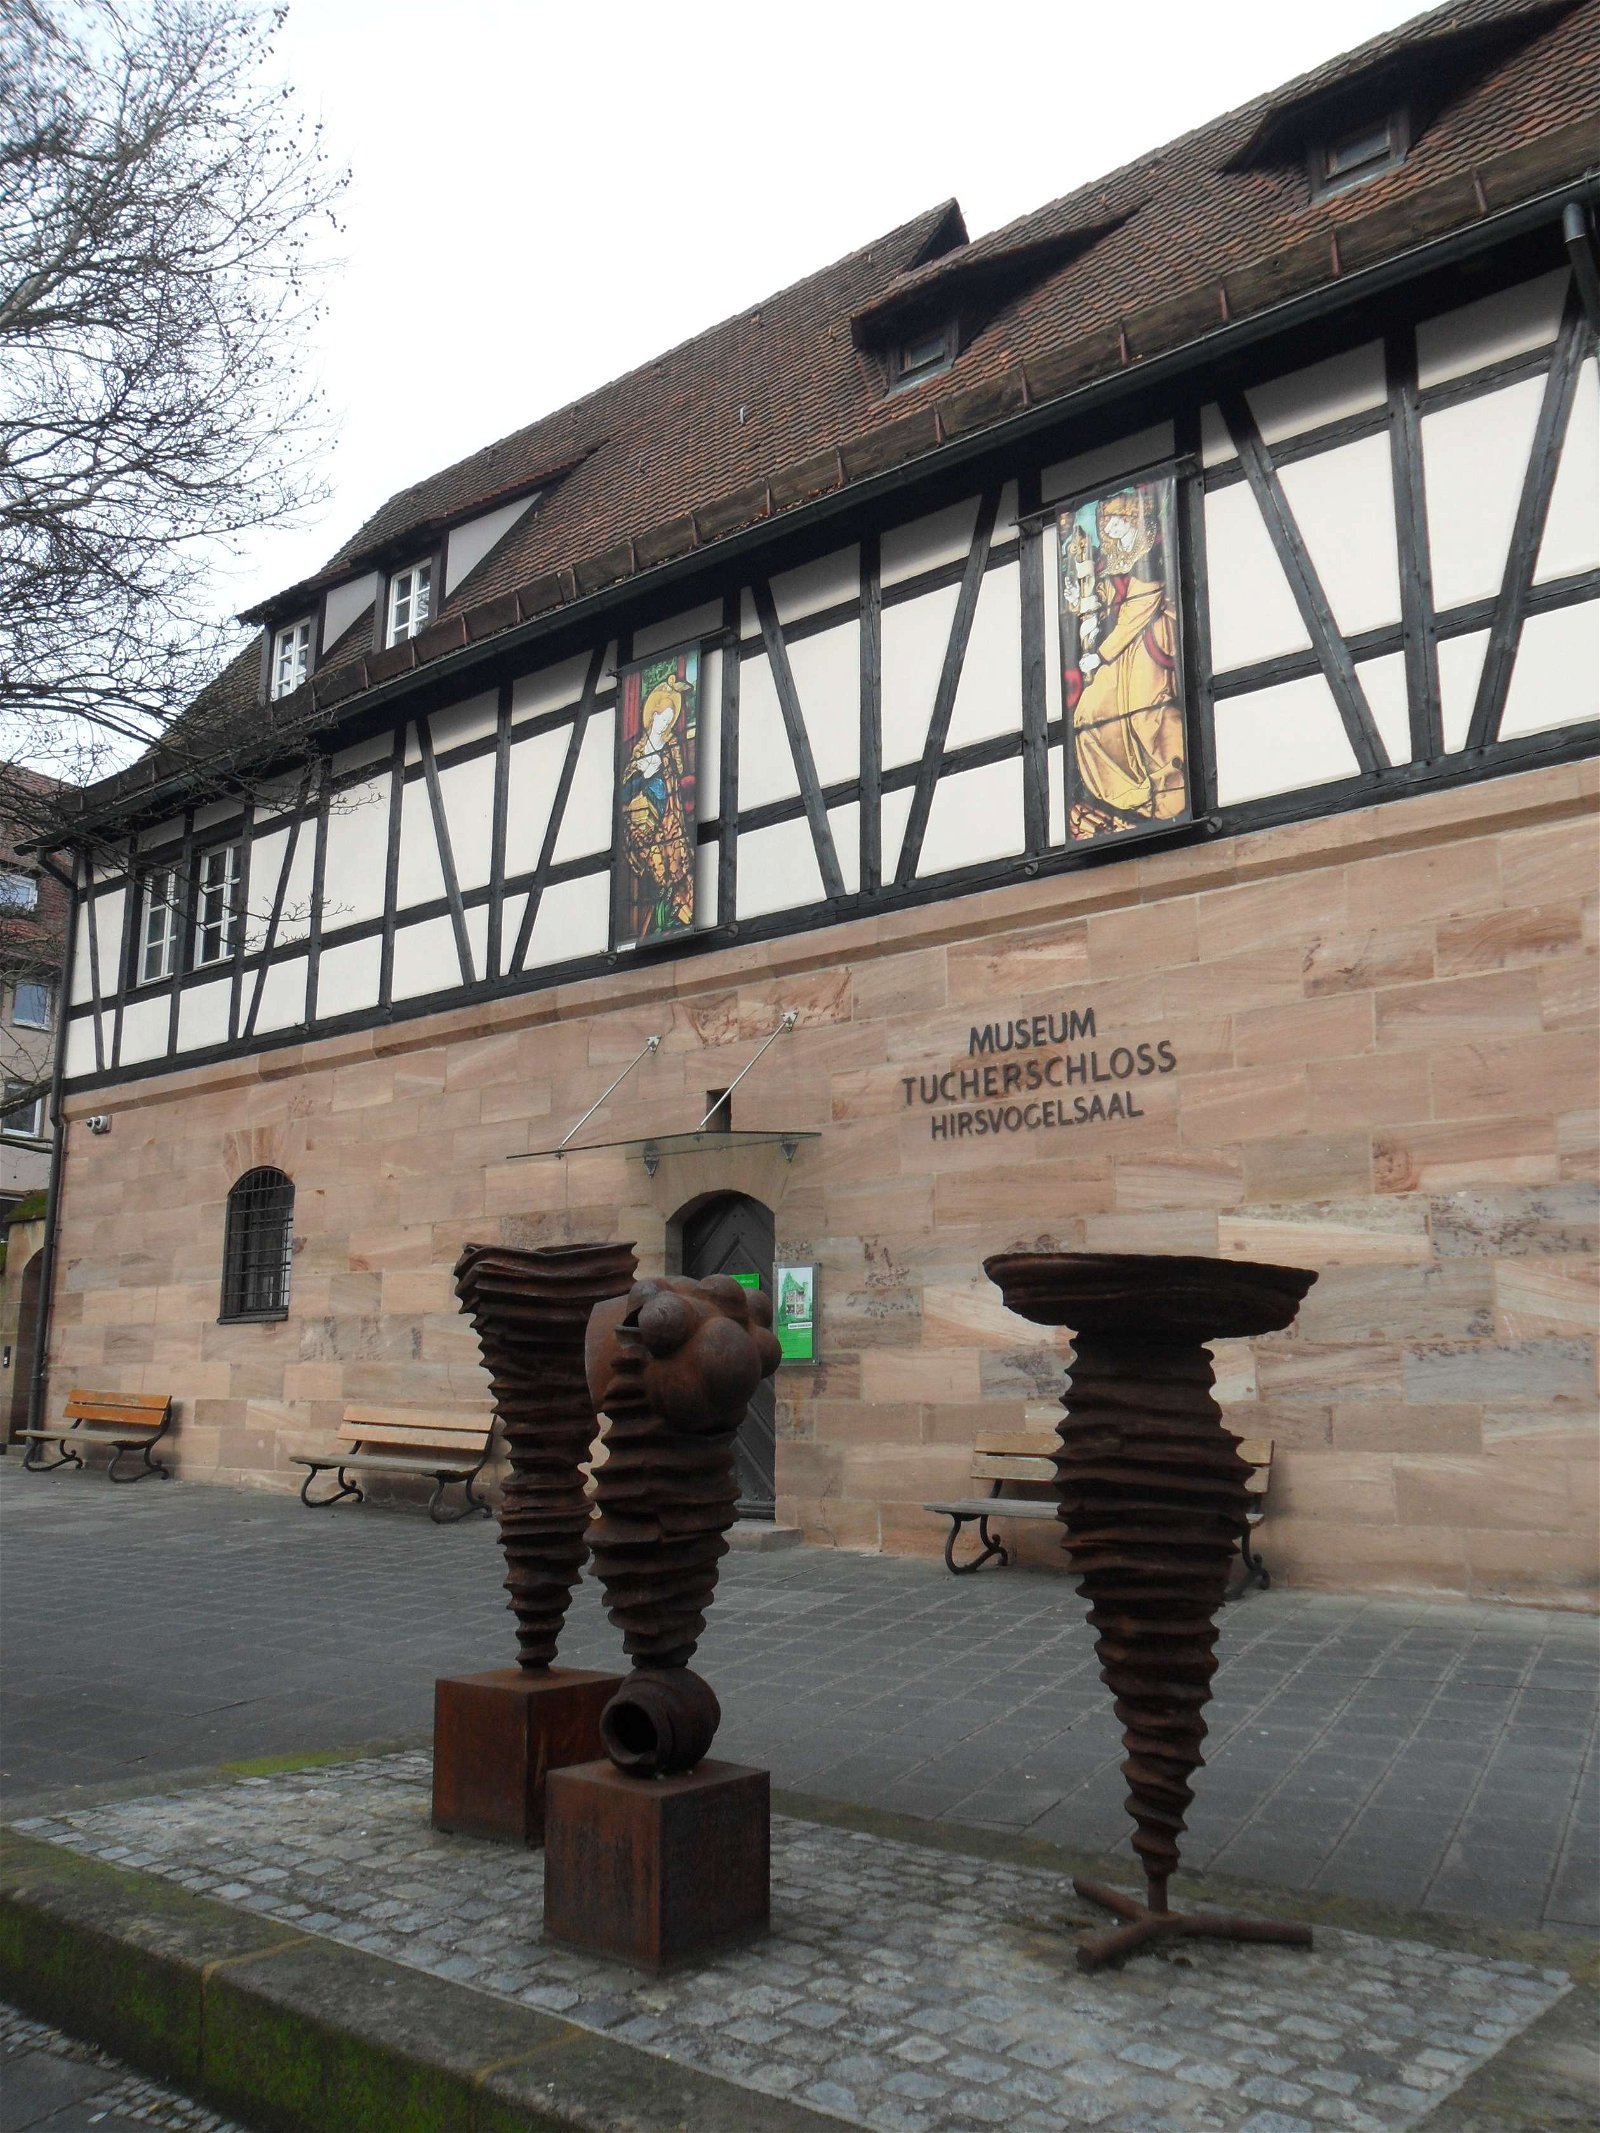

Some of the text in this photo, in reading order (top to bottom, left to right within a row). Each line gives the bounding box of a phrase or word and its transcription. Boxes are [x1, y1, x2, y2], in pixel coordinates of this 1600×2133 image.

[969, 1007, 1096, 1056] MUSEUM
[902, 1040, 1177, 1106] TUCHERSCHLOSS
[931, 1091, 1144, 1140] HIRSVOGELSAAL
